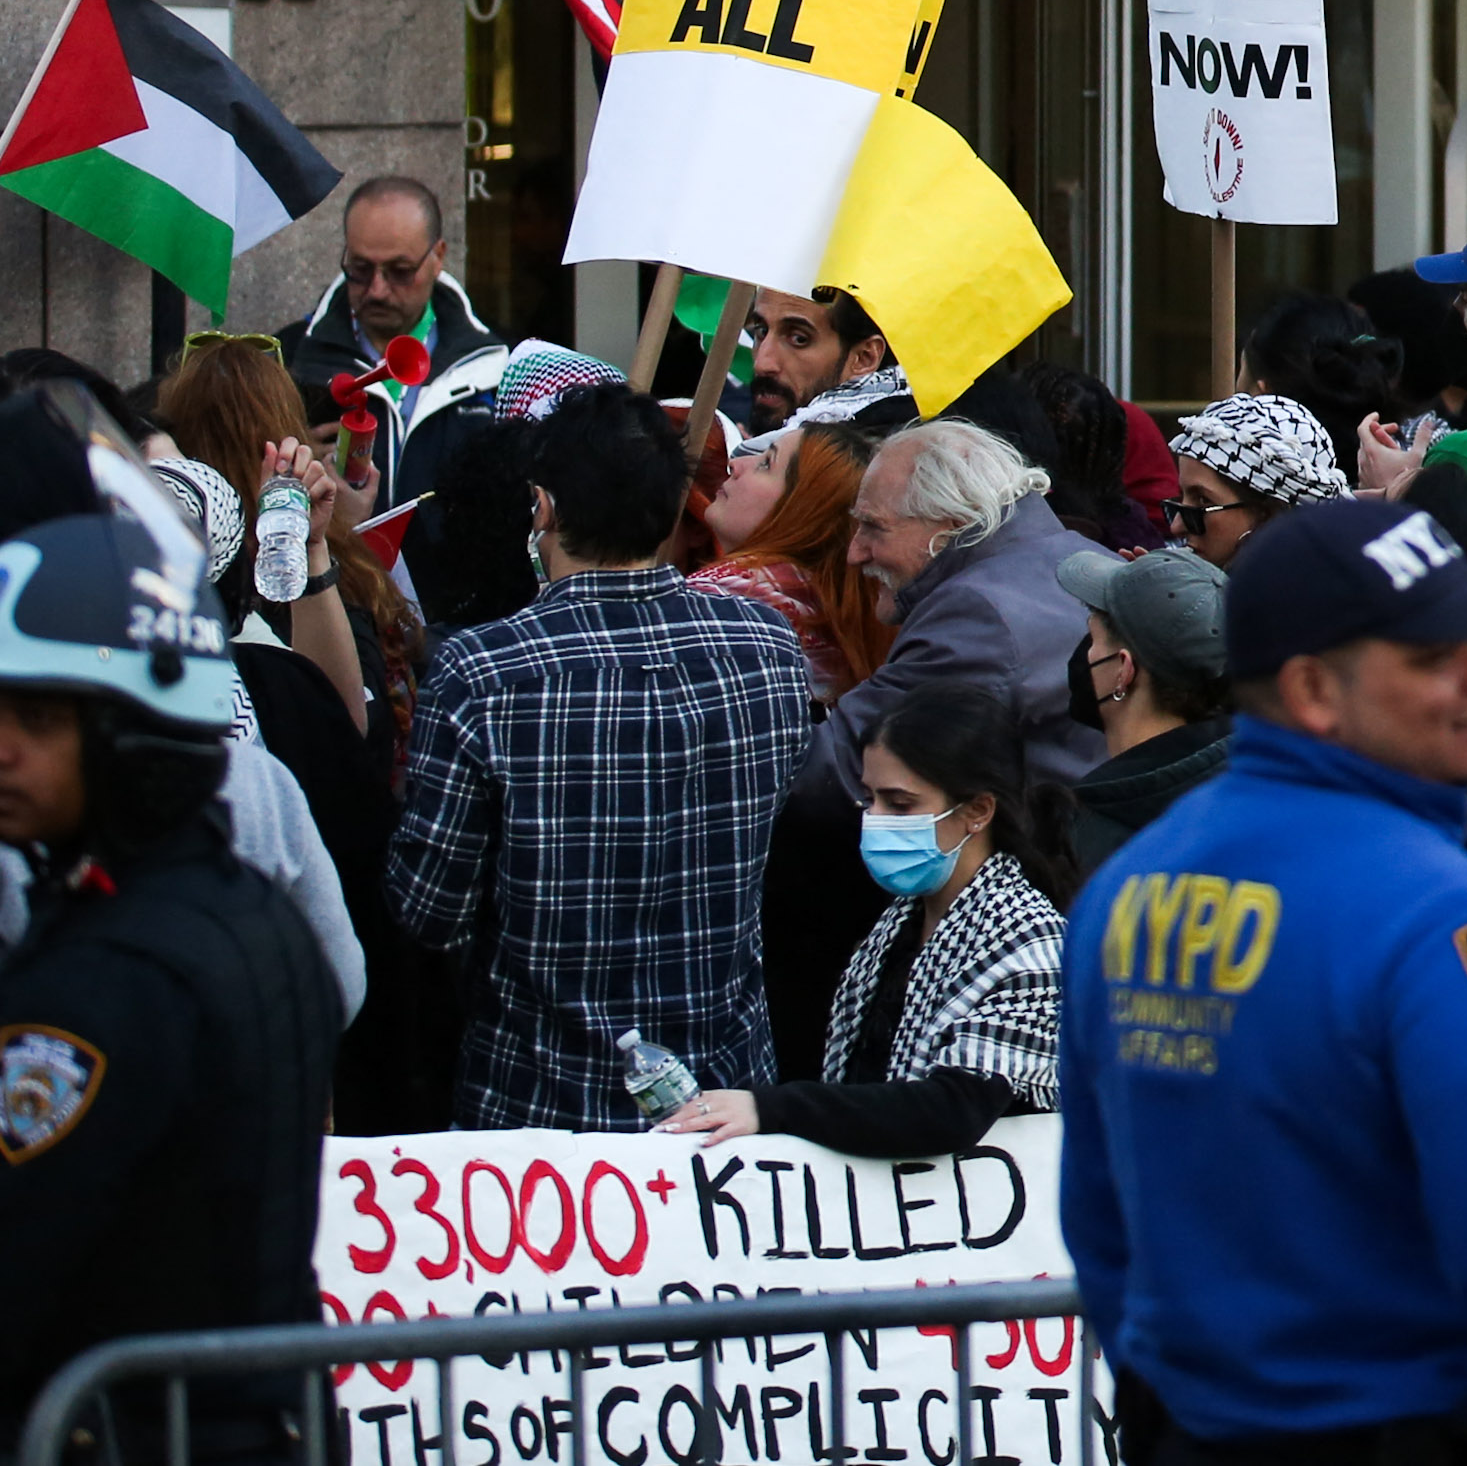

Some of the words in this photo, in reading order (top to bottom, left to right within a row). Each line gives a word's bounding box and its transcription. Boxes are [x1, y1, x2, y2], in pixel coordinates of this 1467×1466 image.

[1159, 31, 1313, 100] NOW!
[1104, 872, 1281, 993] NYPD
[338, 1146, 677, 1284] 33,000+
[690, 1144, 1026, 1261] KILLED
